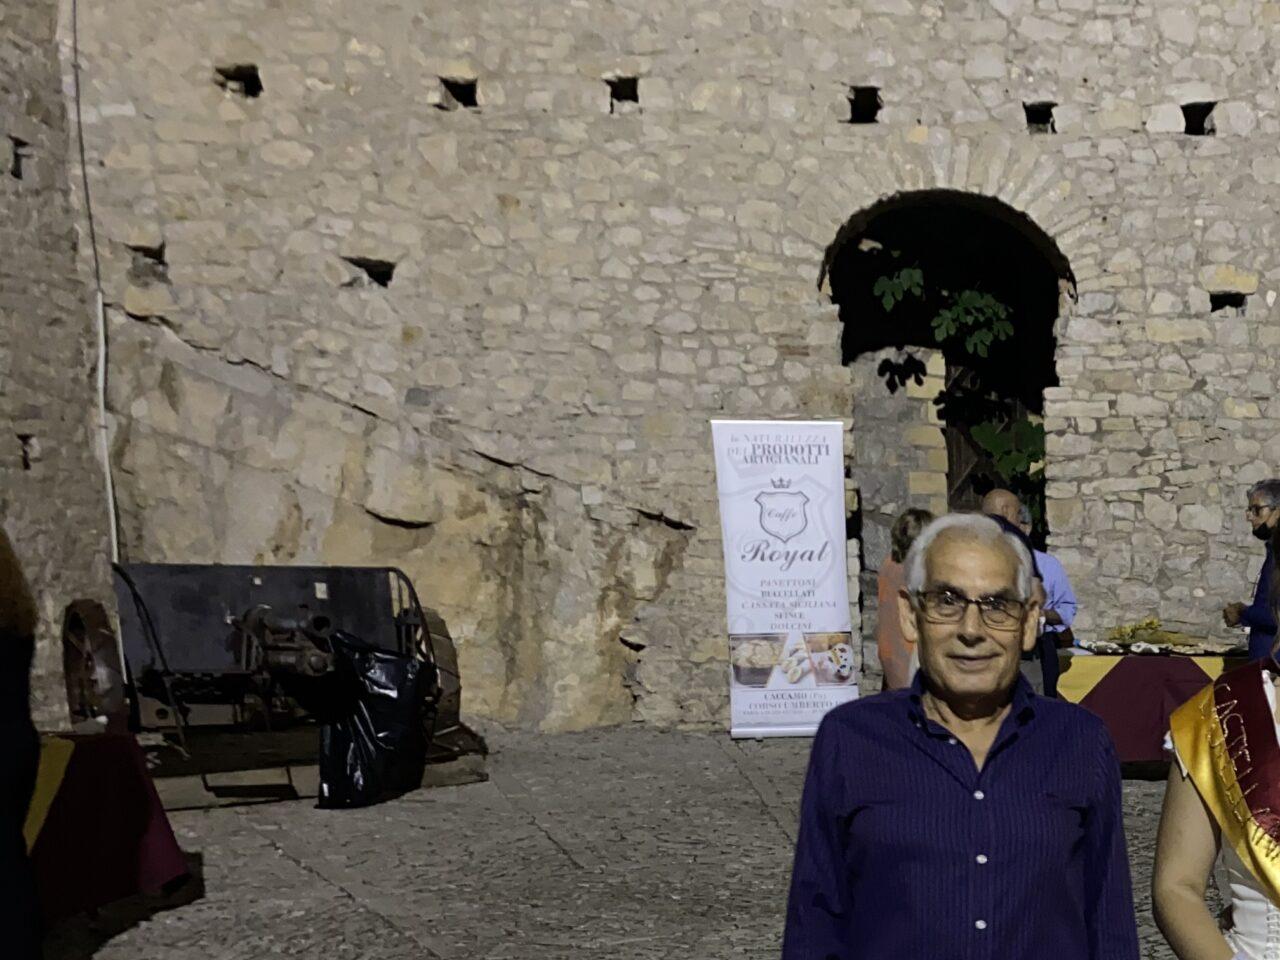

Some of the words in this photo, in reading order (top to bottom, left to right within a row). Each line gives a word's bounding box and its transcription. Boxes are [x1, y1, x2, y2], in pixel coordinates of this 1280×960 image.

[750, 443, 831, 456] PRODOTTI
[743, 455, 820, 465] ARTIGIANALI
[741, 539, 829, 571] Royal
[759, 578, 816, 588] PANETTONI
[741, 600, 786, 609] CASSATA
[789, 600, 838, 609] SICILIANA
[770, 622, 813, 631] DOLCINI
[763, 692, 808, 700] CACCAMO
[748, 702, 782, 711] CORSO
